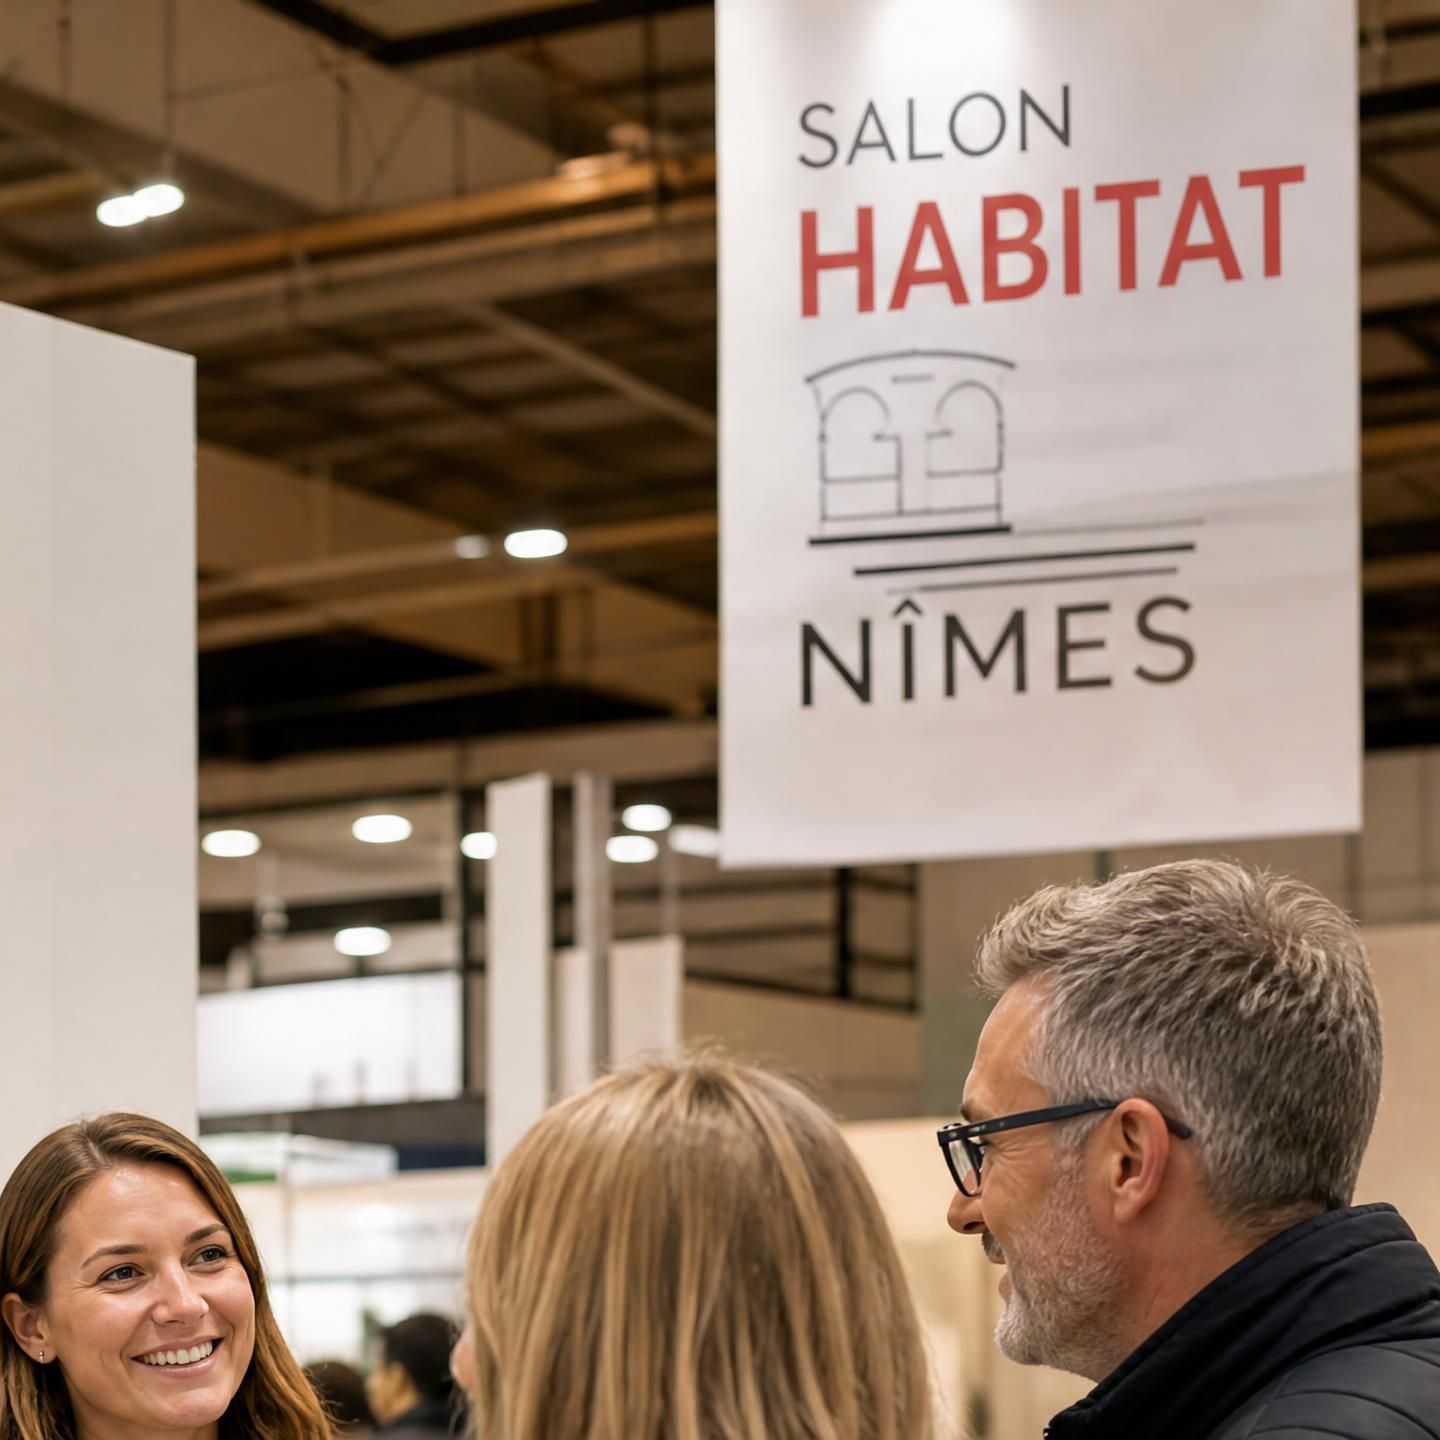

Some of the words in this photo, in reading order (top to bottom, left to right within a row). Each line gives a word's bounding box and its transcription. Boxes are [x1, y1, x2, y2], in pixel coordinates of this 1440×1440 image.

[798, 84, 1072, 170] SALON
[800, 164, 1306, 319] HABITAT
[800, 596, 1197, 708] NÎMES
